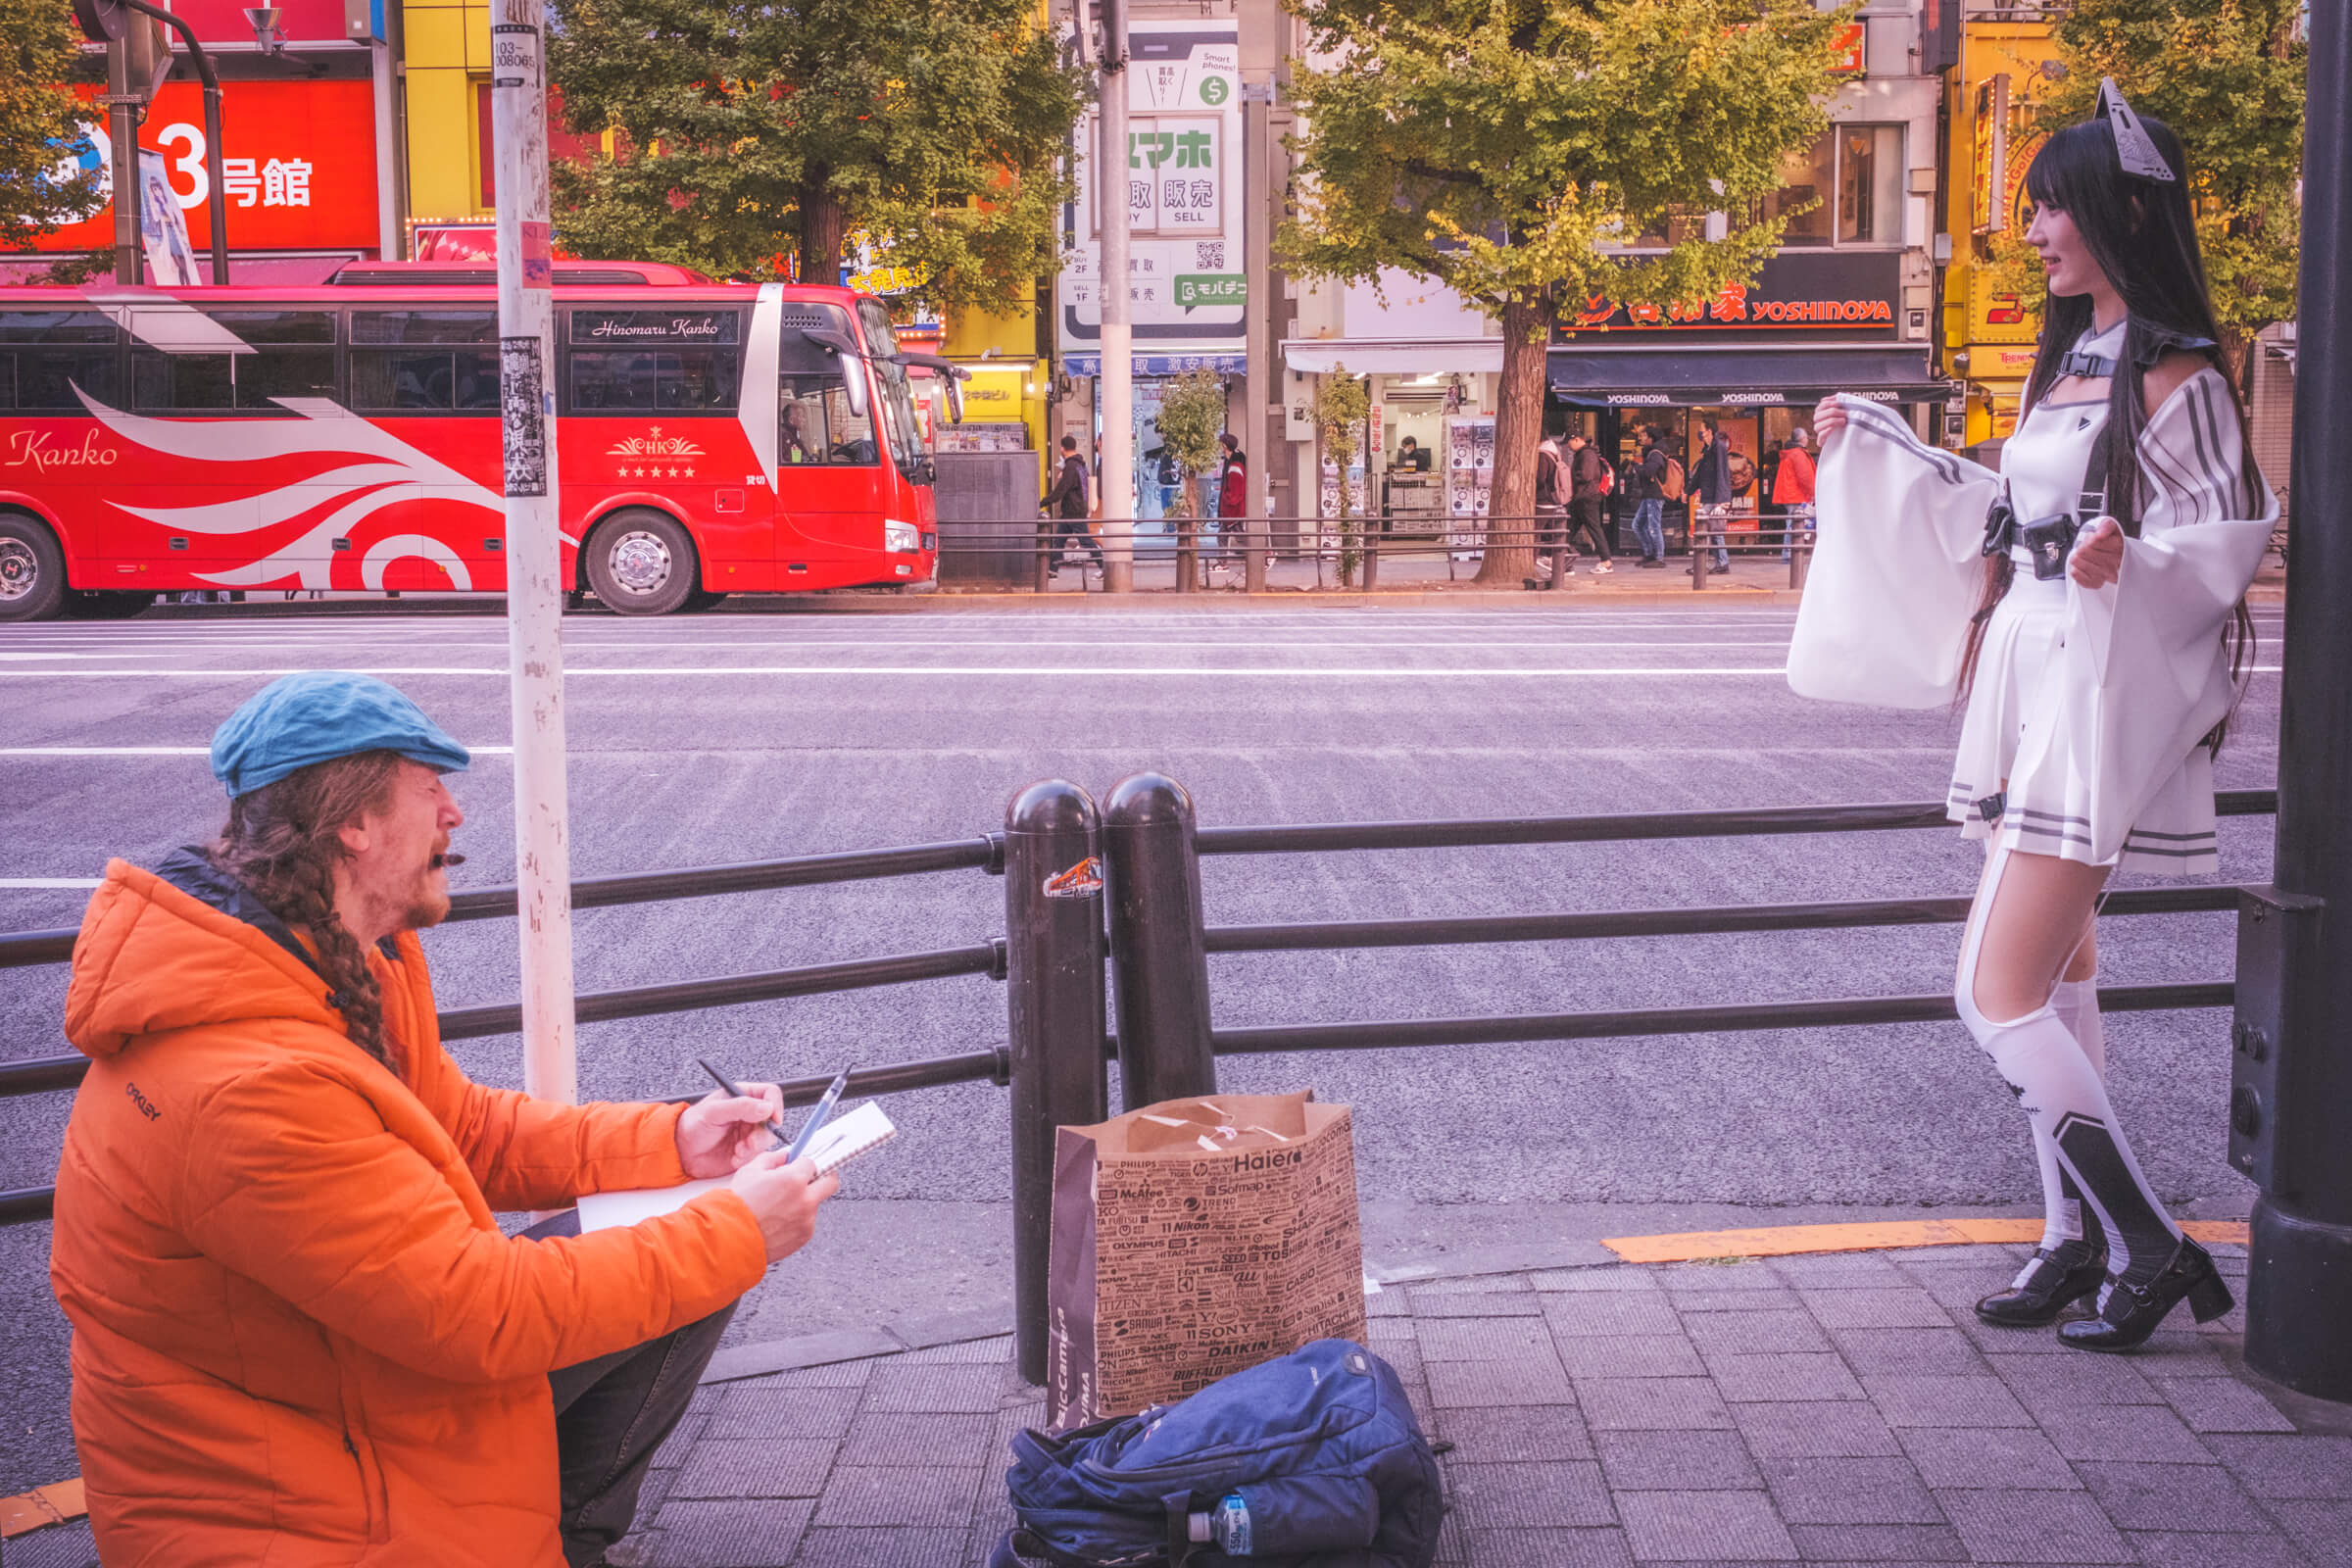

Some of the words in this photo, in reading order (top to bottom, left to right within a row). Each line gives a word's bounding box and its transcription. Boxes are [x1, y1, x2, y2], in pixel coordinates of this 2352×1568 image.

[1203, 53, 1230, 63] Smart
[1174, 212, 1204, 221] SELL
[1075, 265, 1088, 273] 2F
[1076, 292, 1088, 302] 1F
[1752, 300, 1891, 321] YOSHINOYA
[592, 319, 667, 337] Hinomaru
[669, 318, 718, 337] Kanko
[1607, 394, 1670, 404] YOSHINOYA
[1722, 392, 1785, 403] YOSHINOYA
[4, 427, 118, 474] Kanko
[646, 441, 669, 455] HK
[1120, 1159, 1156, 1168] PHILIPS
[1235, 1150, 1293, 1173] Haier
[1120, 1189, 1164, 1199] McAfee
[1218, 1182, 1264, 1196] Sofmap
[1202, 1197, 1237, 1207] TREND
[1174, 1221, 1209, 1233] Nikon
[1112, 1240, 1165, 1250] OLYMPUS
[1262, 1238, 1309, 1261] TOSHIBA
[1155, 1249, 1198, 1259] HITACHI
[1286, 1267, 1315, 1292] CASIO
[1129, 1316, 1162, 1330] SANWA
[1307, 1309, 1350, 1336] HITACHI
[1199, 1324, 1252, 1340] SONY
[1101, 1348, 1136, 1359] PHILIPS
[1208, 1340, 1270, 1358] DAIKIN
[1173, 1365, 1224, 1381] BUFFALO
